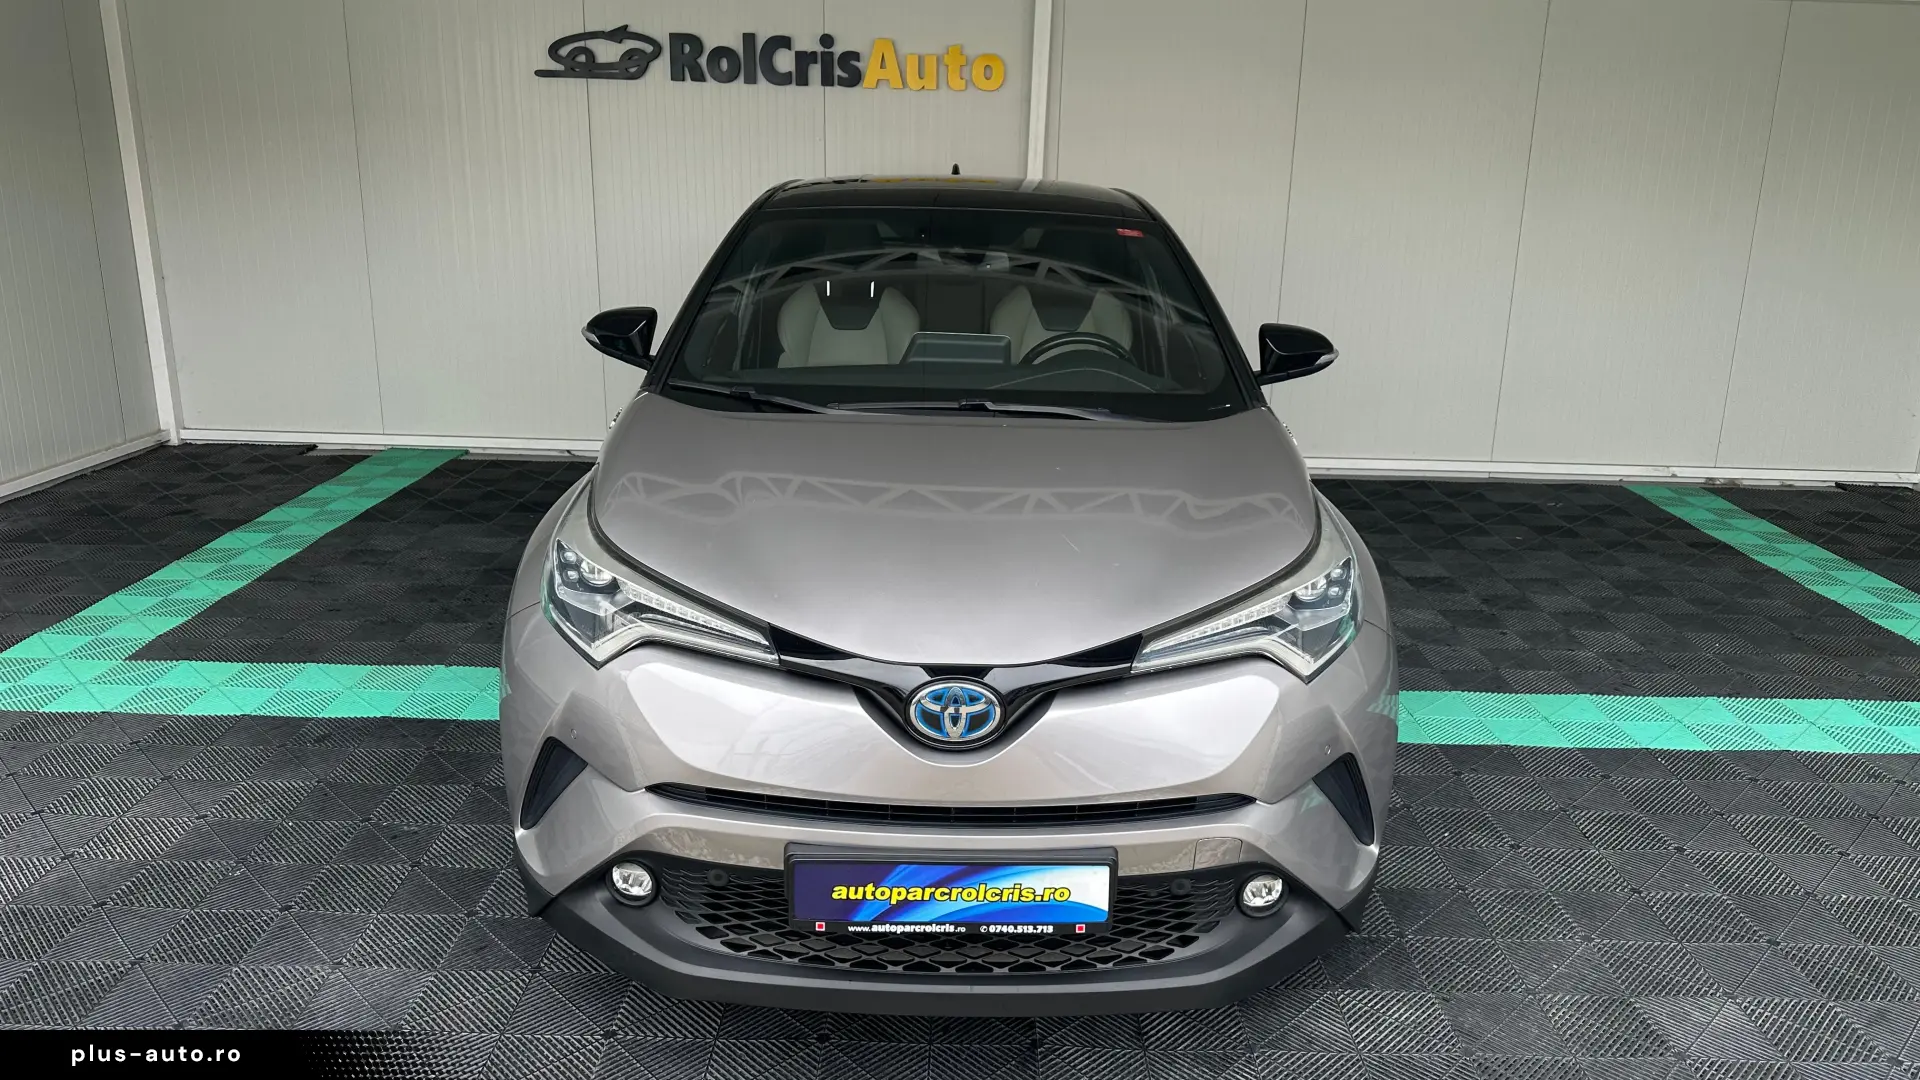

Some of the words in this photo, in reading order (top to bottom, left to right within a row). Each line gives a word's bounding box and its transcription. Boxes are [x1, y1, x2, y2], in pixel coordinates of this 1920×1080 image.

[668, 32, 1006, 92] RolCrisAuto
[831, 882, 1071, 905] autoparcrolcris.ro
[988, 924, 1054, 934] 0740.513.713
